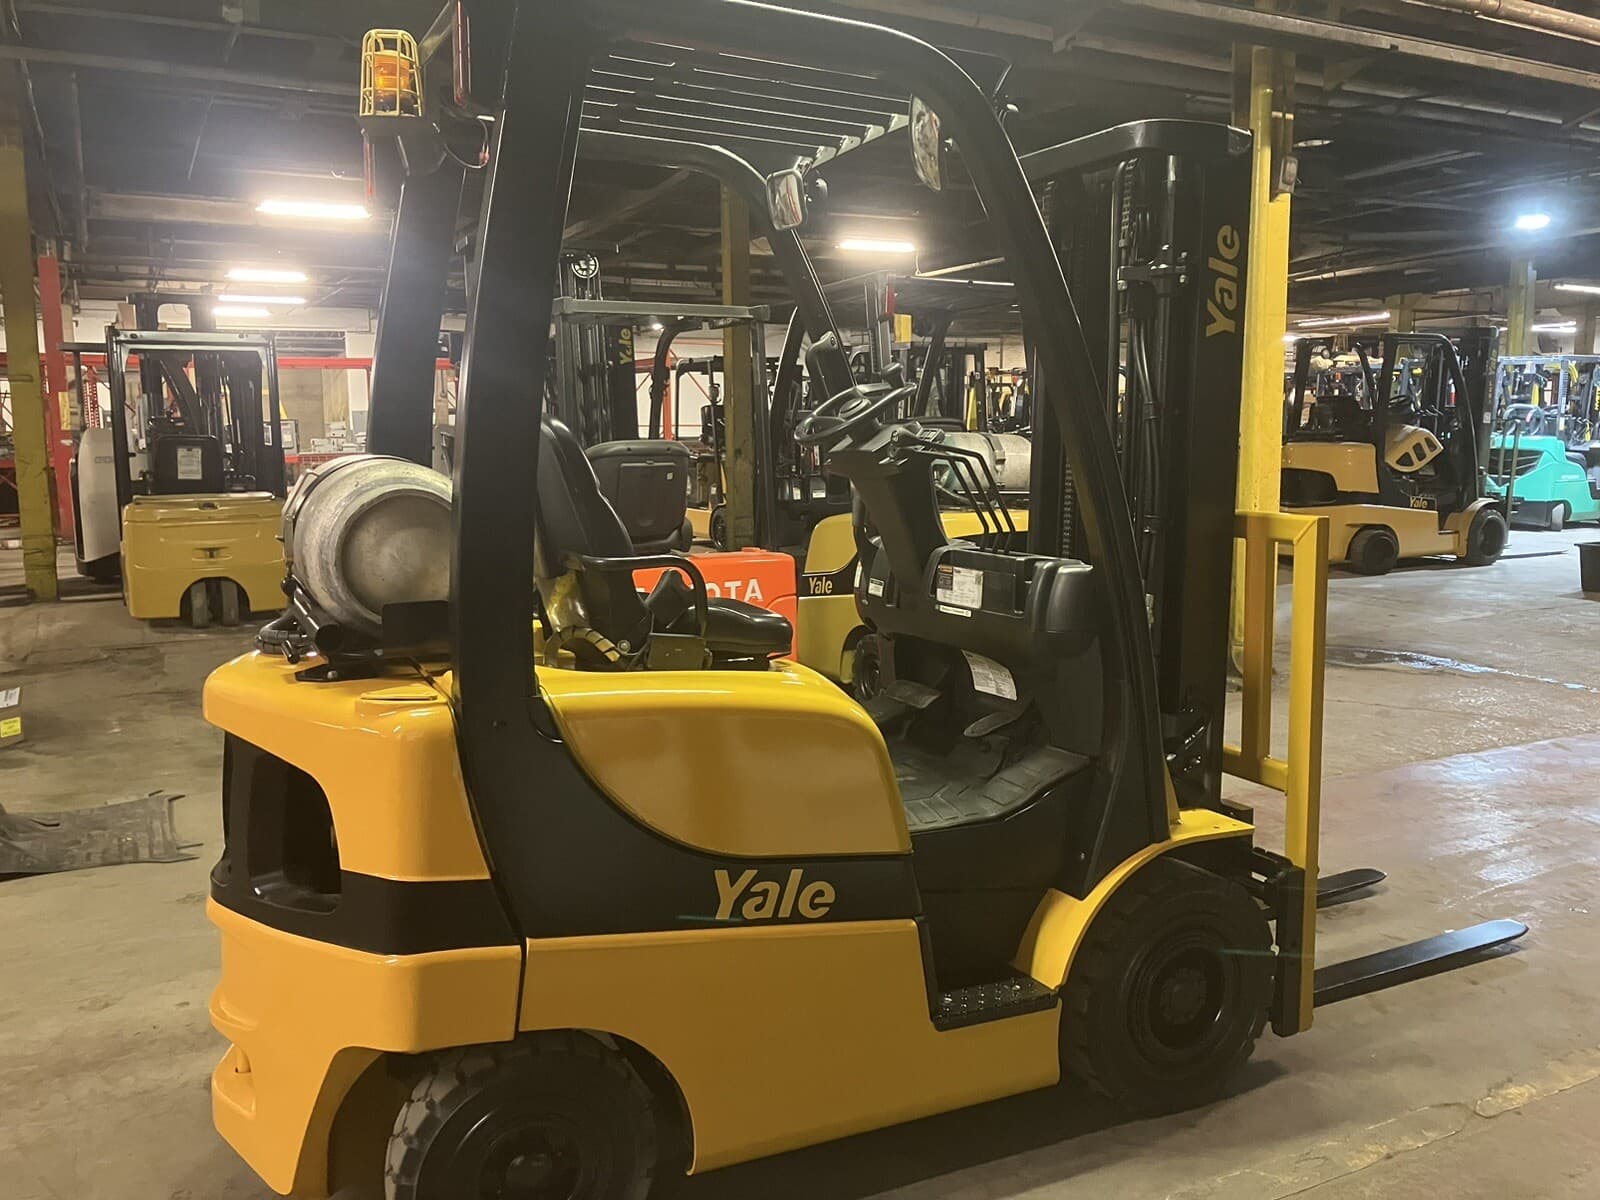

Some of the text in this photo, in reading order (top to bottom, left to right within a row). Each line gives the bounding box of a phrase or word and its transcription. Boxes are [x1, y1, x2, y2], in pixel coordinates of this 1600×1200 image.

[1206, 224, 1240, 337] Yale
[619, 328, 632, 365] Yale
[1410, 496, 1428, 509] Yale
[809, 576, 833, 595] Yale
[714, 868, 836, 920] Yale
